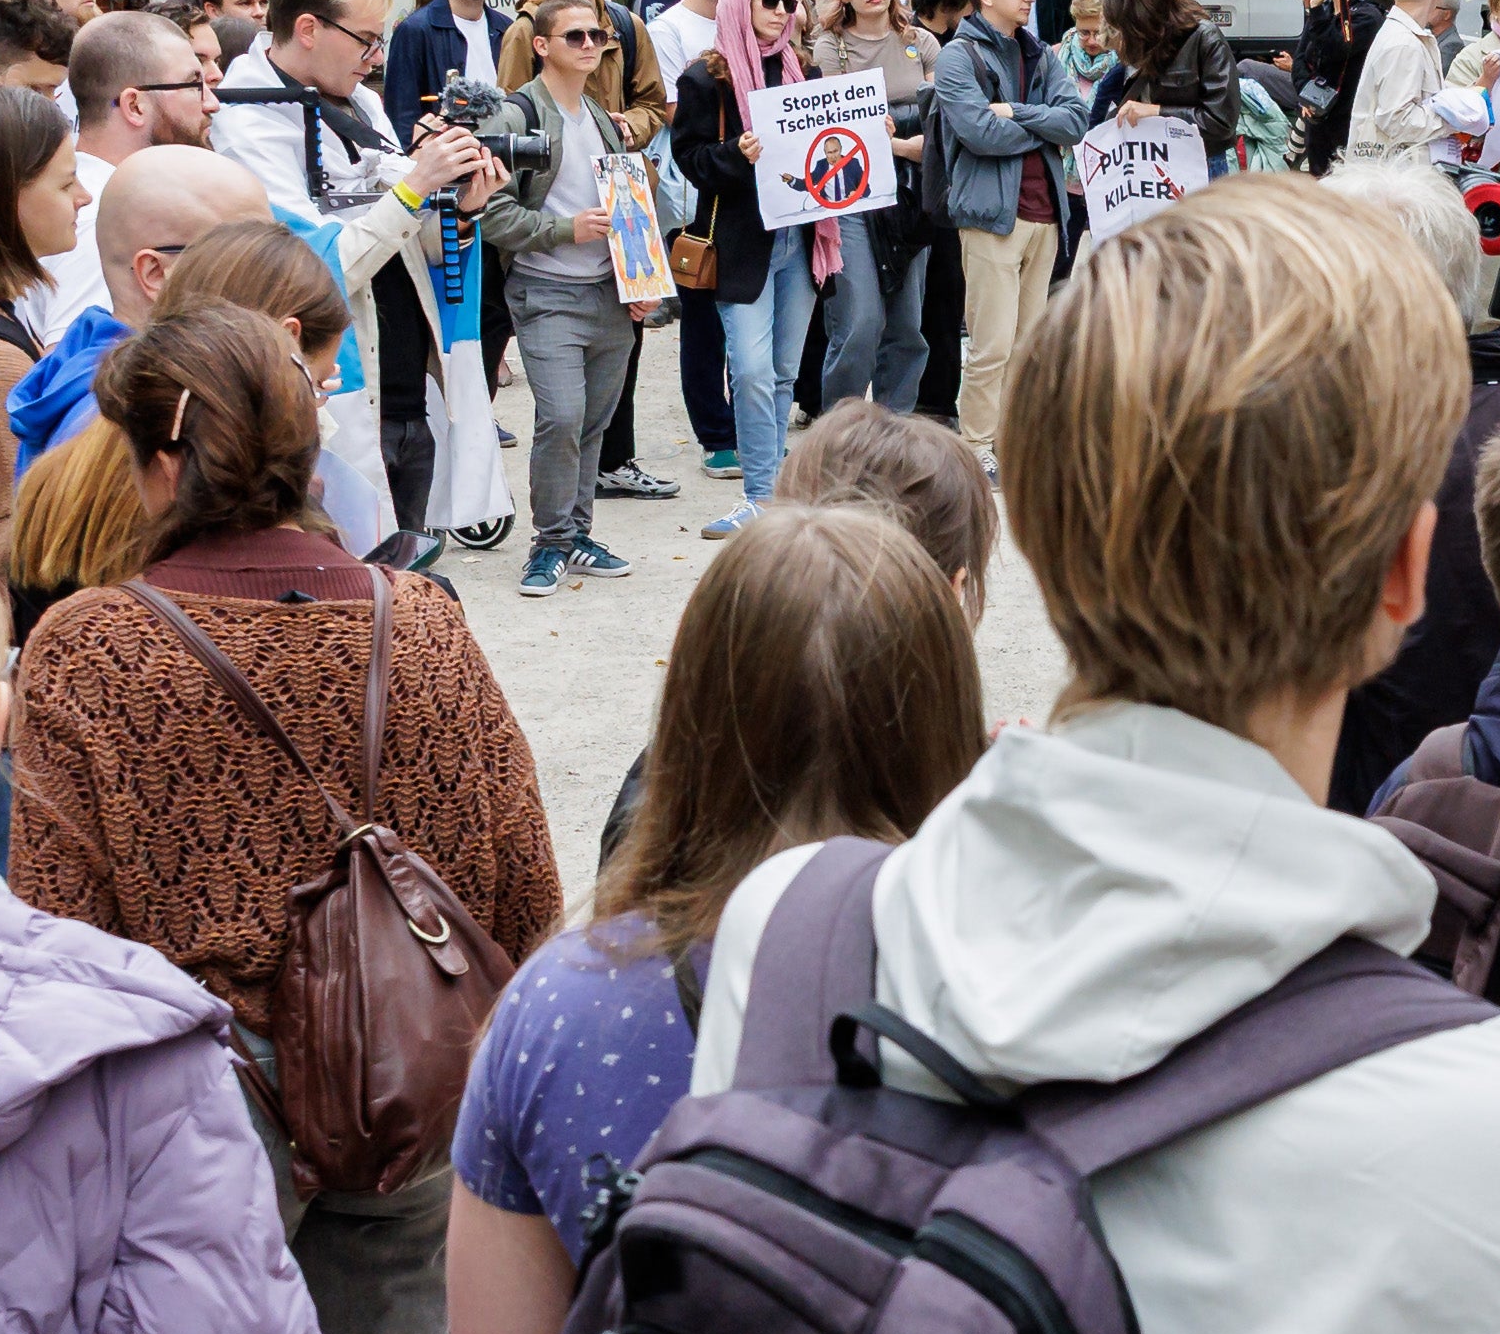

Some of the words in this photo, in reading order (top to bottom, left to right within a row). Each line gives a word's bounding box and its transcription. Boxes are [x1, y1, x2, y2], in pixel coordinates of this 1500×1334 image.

[782, 89, 840, 113] Stoppt
[844, 85, 876, 101] den
[776, 102, 887, 135] Tschekismus
[1099, 141, 1169, 175] PUTIN
[1104, 179, 1176, 212] KILLER
